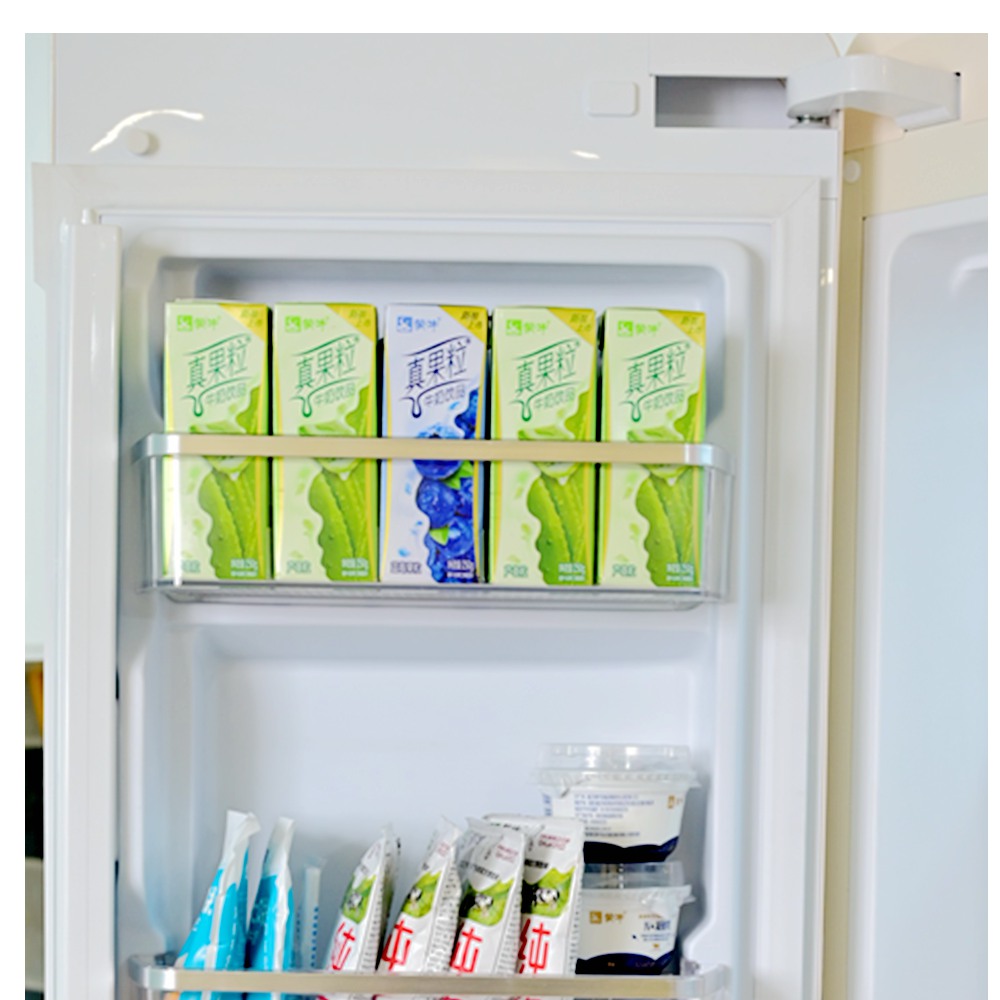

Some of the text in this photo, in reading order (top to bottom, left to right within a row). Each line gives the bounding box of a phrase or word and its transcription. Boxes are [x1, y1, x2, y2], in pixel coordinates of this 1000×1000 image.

[187, 342, 247, 391] 真果粒
[296, 343, 356, 392] 真果粒
[406, 343, 467, 393] 真果粒
[516, 344, 577, 395] 真果粒
[627, 344, 687, 396] 真果粒
